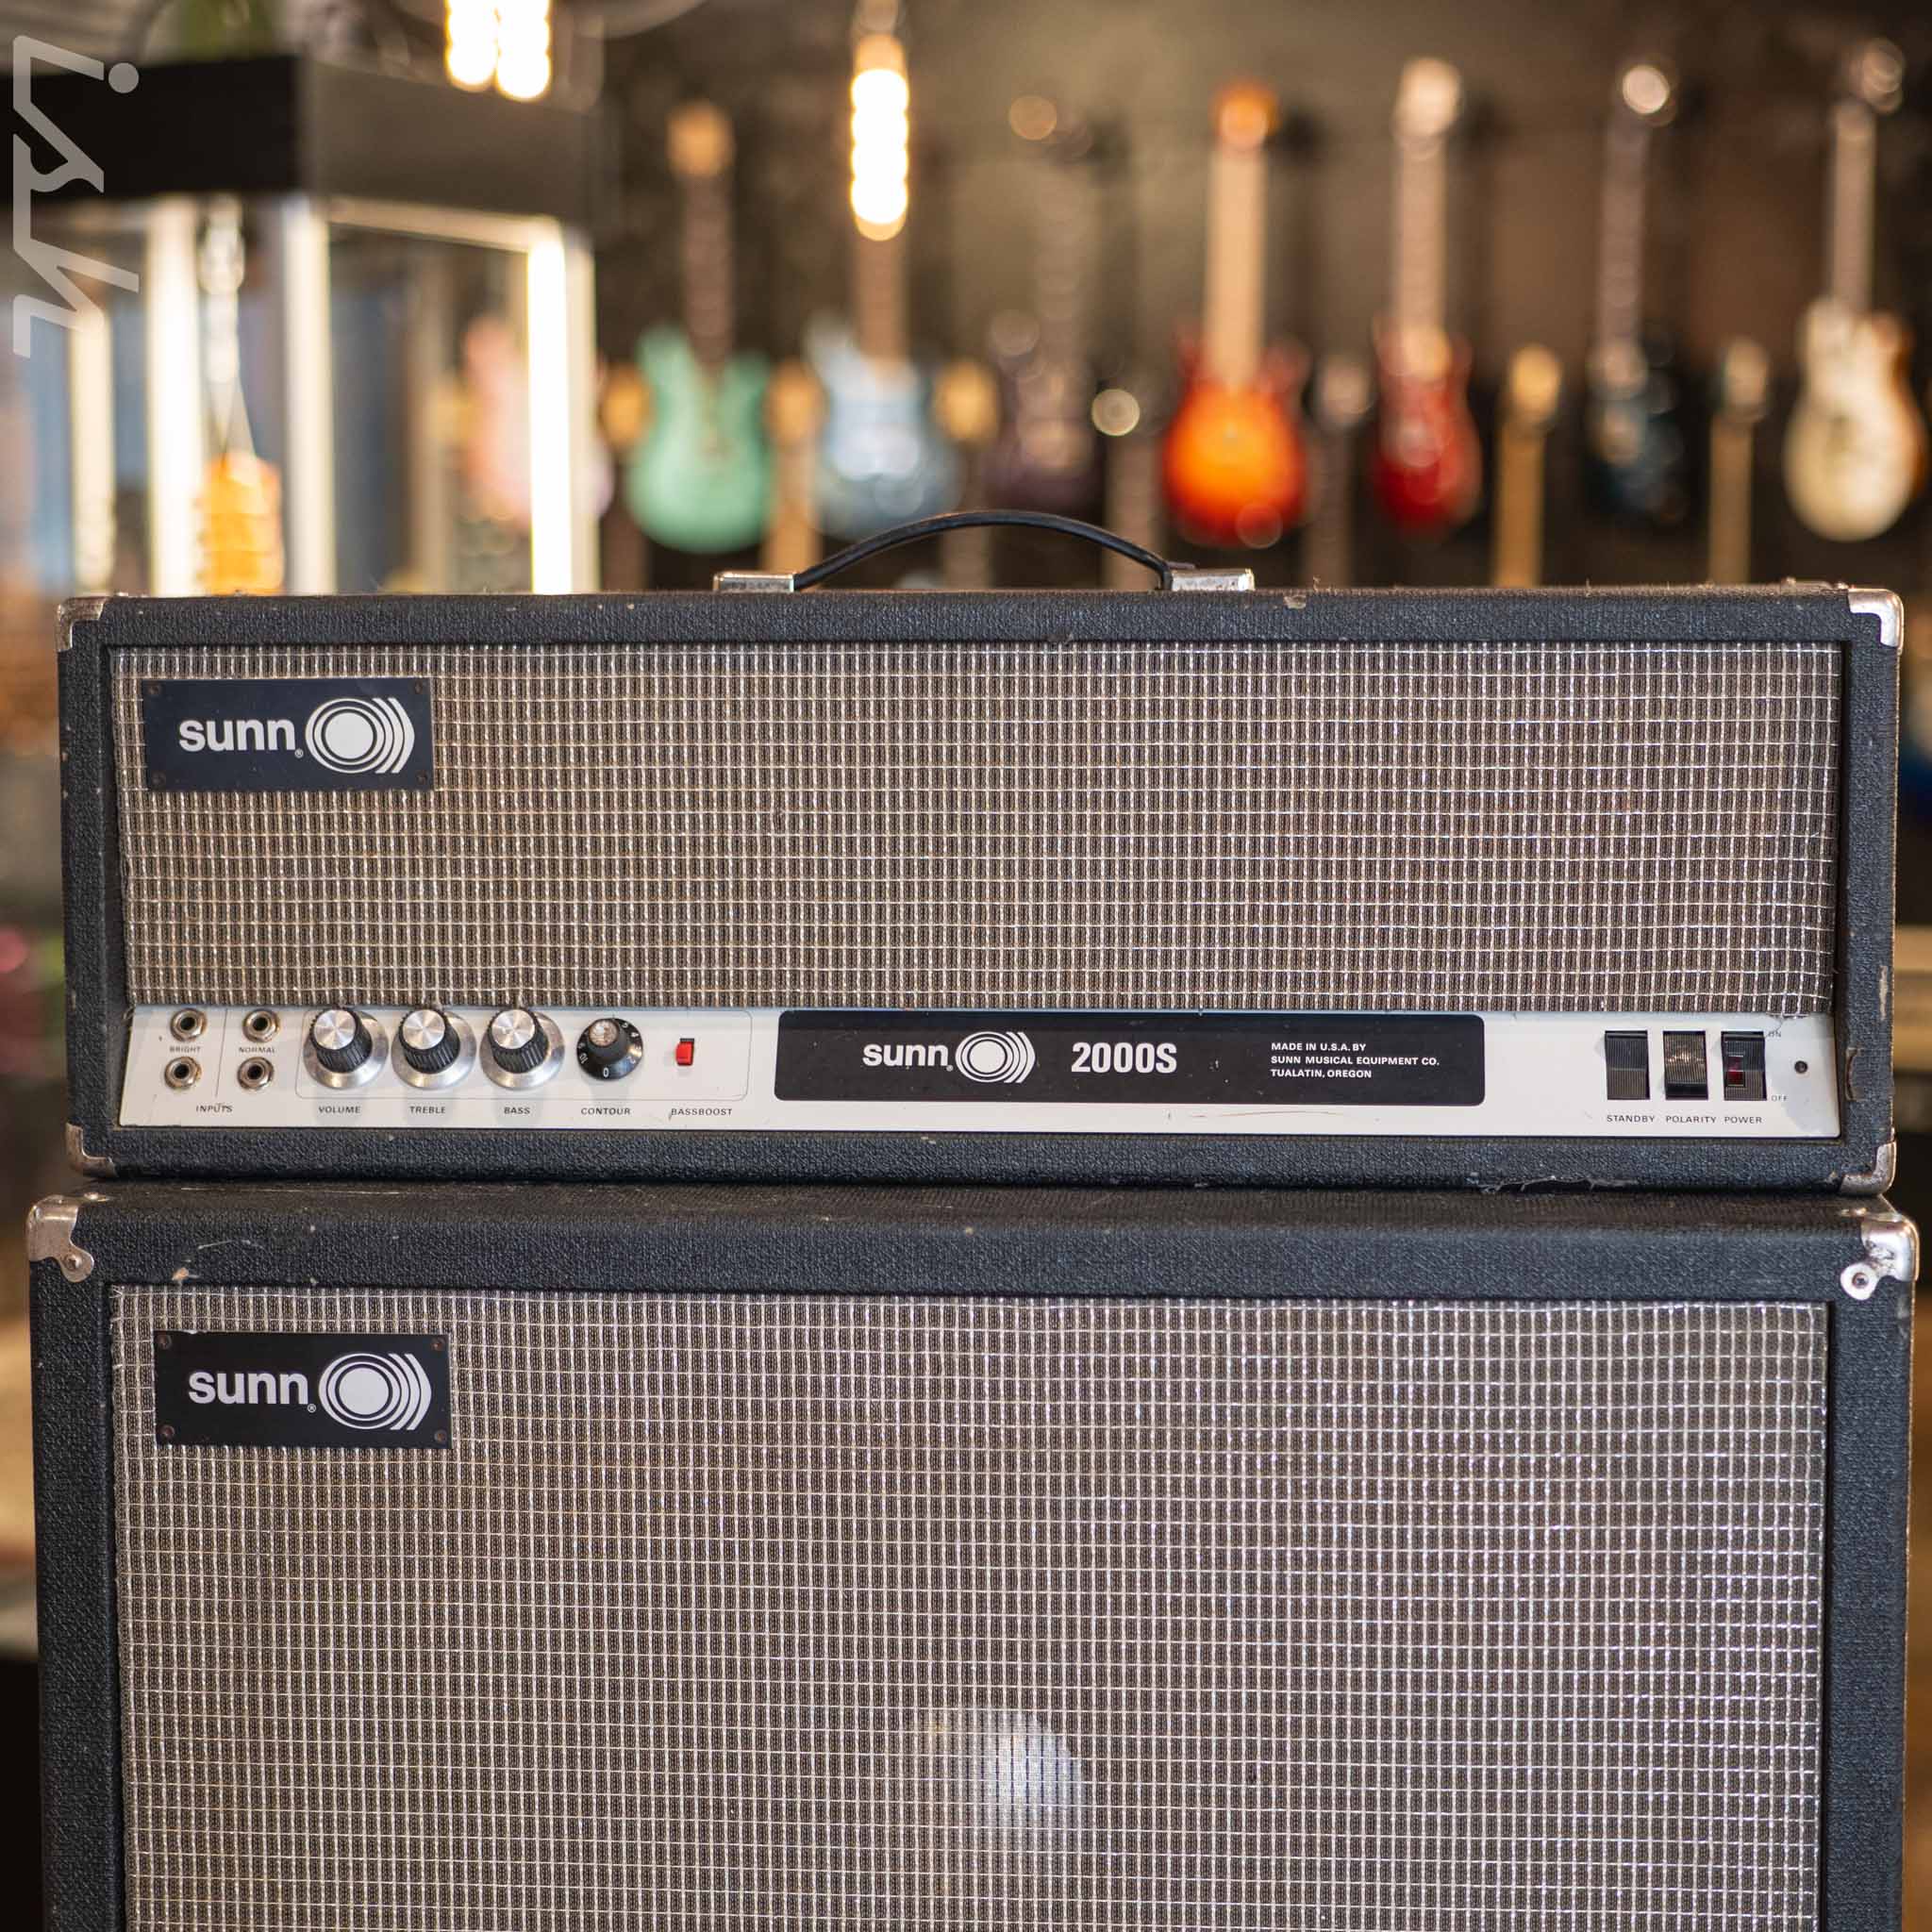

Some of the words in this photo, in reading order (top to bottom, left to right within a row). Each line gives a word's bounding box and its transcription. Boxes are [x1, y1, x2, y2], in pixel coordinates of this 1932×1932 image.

[178, 718, 296, 752] sunn
[1271, 1042, 1303, 1051] MADE
[1306, 1042, 1317, 1051] IN
[1320, 1042, 1351, 1052] U.S.A.
[1352, 1042, 1367, 1052] BY
[862, 1043, 948, 1067] sunn
[1071, 1041, 1177, 1074] 2000S
[1271, 1056, 1301, 1064] SUNN
[1305, 1056, 1353, 1065] MUSICAL
[1356, 1057, 1419, 1066] EQUIPMENT
[1421, 1057, 1440, 1066] CO.
[1270, 1068, 1325, 1078] TUALATIN,
[1326, 1069, 1372, 1078] OREGON
[195, 1105, 233, 1113] INPUTS
[318, 1106, 361, 1114] VOLUME
[409, 1106, 446, 1114] TREBLE
[504, 1107, 530, 1115] BASS
[580, 1107, 631, 1116] CONTOUR
[671, 1108, 733, 1116] BASSBOOST
[1607, 1114, 1655, 1123] STANDBY
[1665, 1115, 1717, 1124] POLARITY
[1724, 1116, 1762, 1124] POWER
[188, 1371, 308, 1405] sunn
